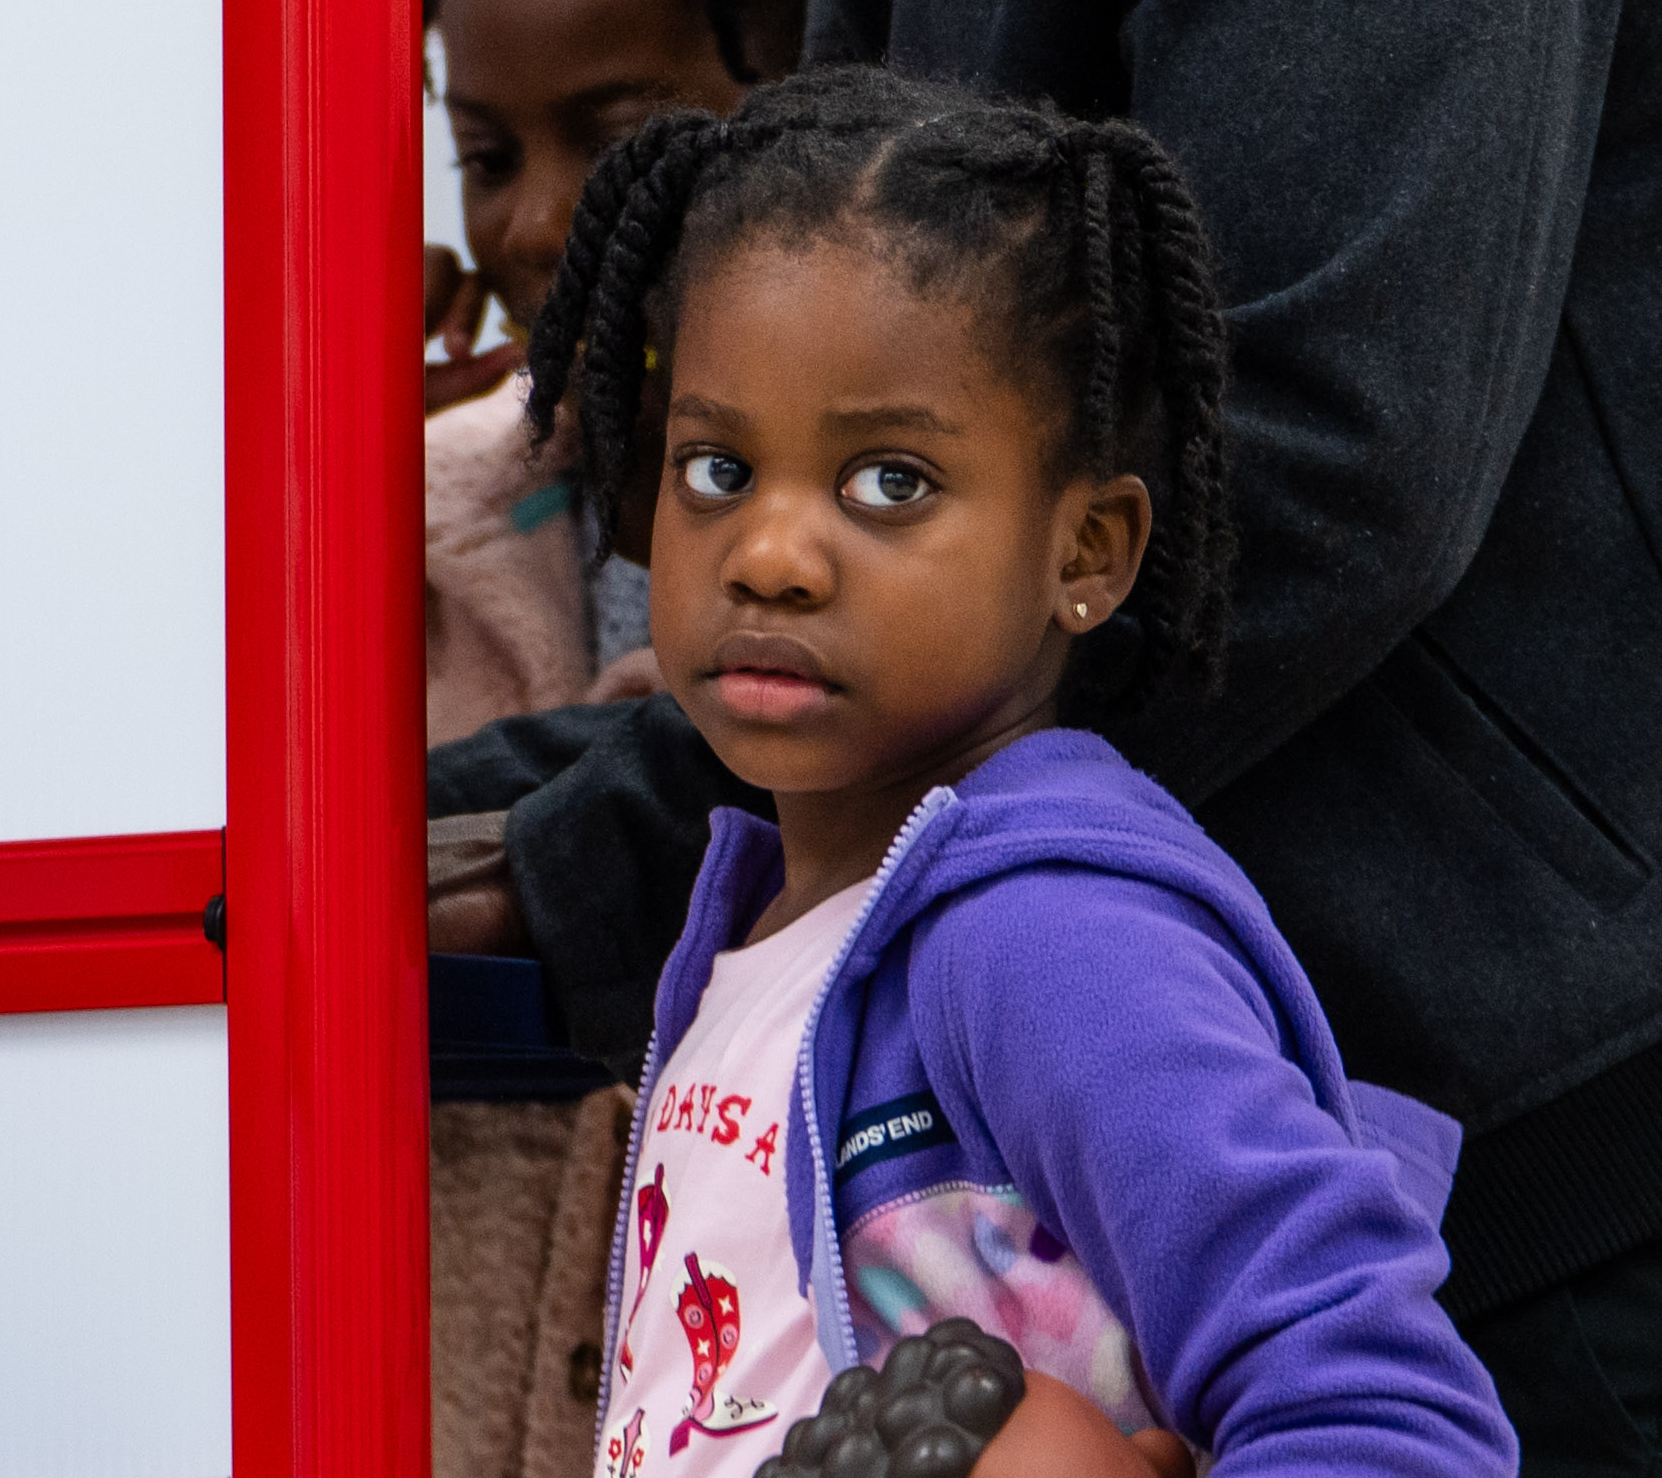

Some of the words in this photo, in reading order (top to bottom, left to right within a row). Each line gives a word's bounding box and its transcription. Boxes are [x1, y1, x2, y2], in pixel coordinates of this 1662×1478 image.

[657, 1083, 752, 1147] DAYS
[744, 1121, 780, 1177] A
[887, 1110, 934, 1141] END
